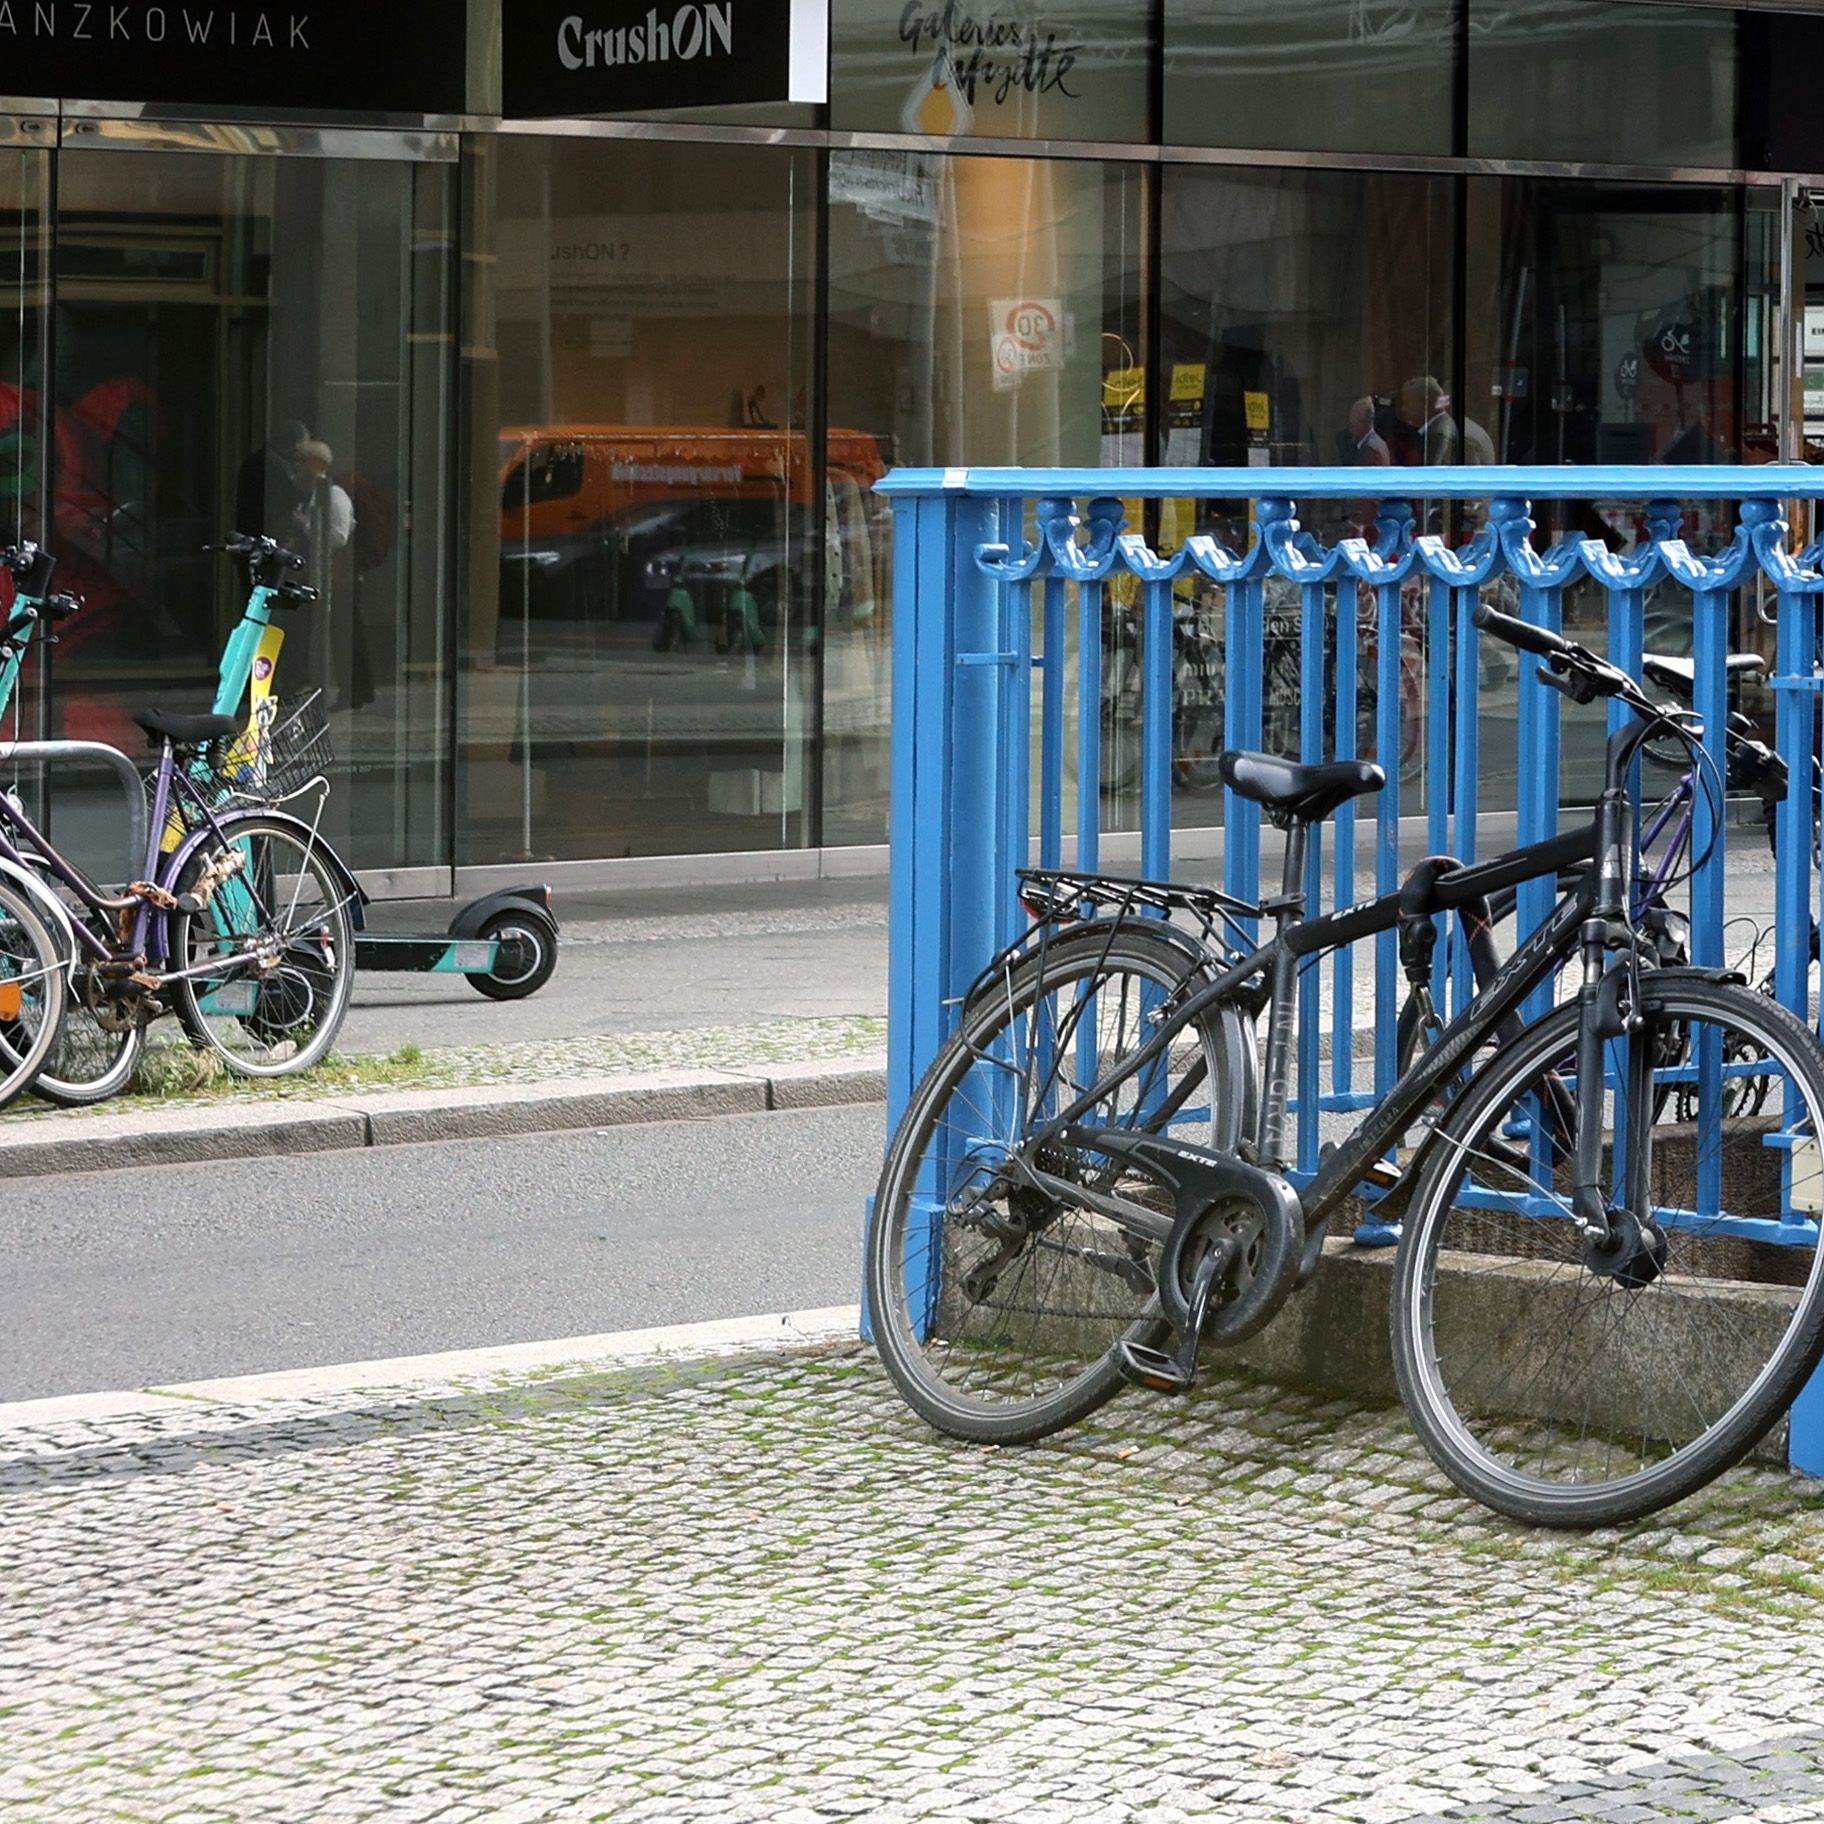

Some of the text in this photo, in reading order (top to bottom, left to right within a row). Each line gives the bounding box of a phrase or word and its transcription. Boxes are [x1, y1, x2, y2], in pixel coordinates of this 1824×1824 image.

[0, 0, 309, 49] ANZKOWIAK
[557, 2, 732, 70] CrushON
[1331, 896, 1380, 922] EXTE
[1177, 1150, 1218, 1168] EXTE
